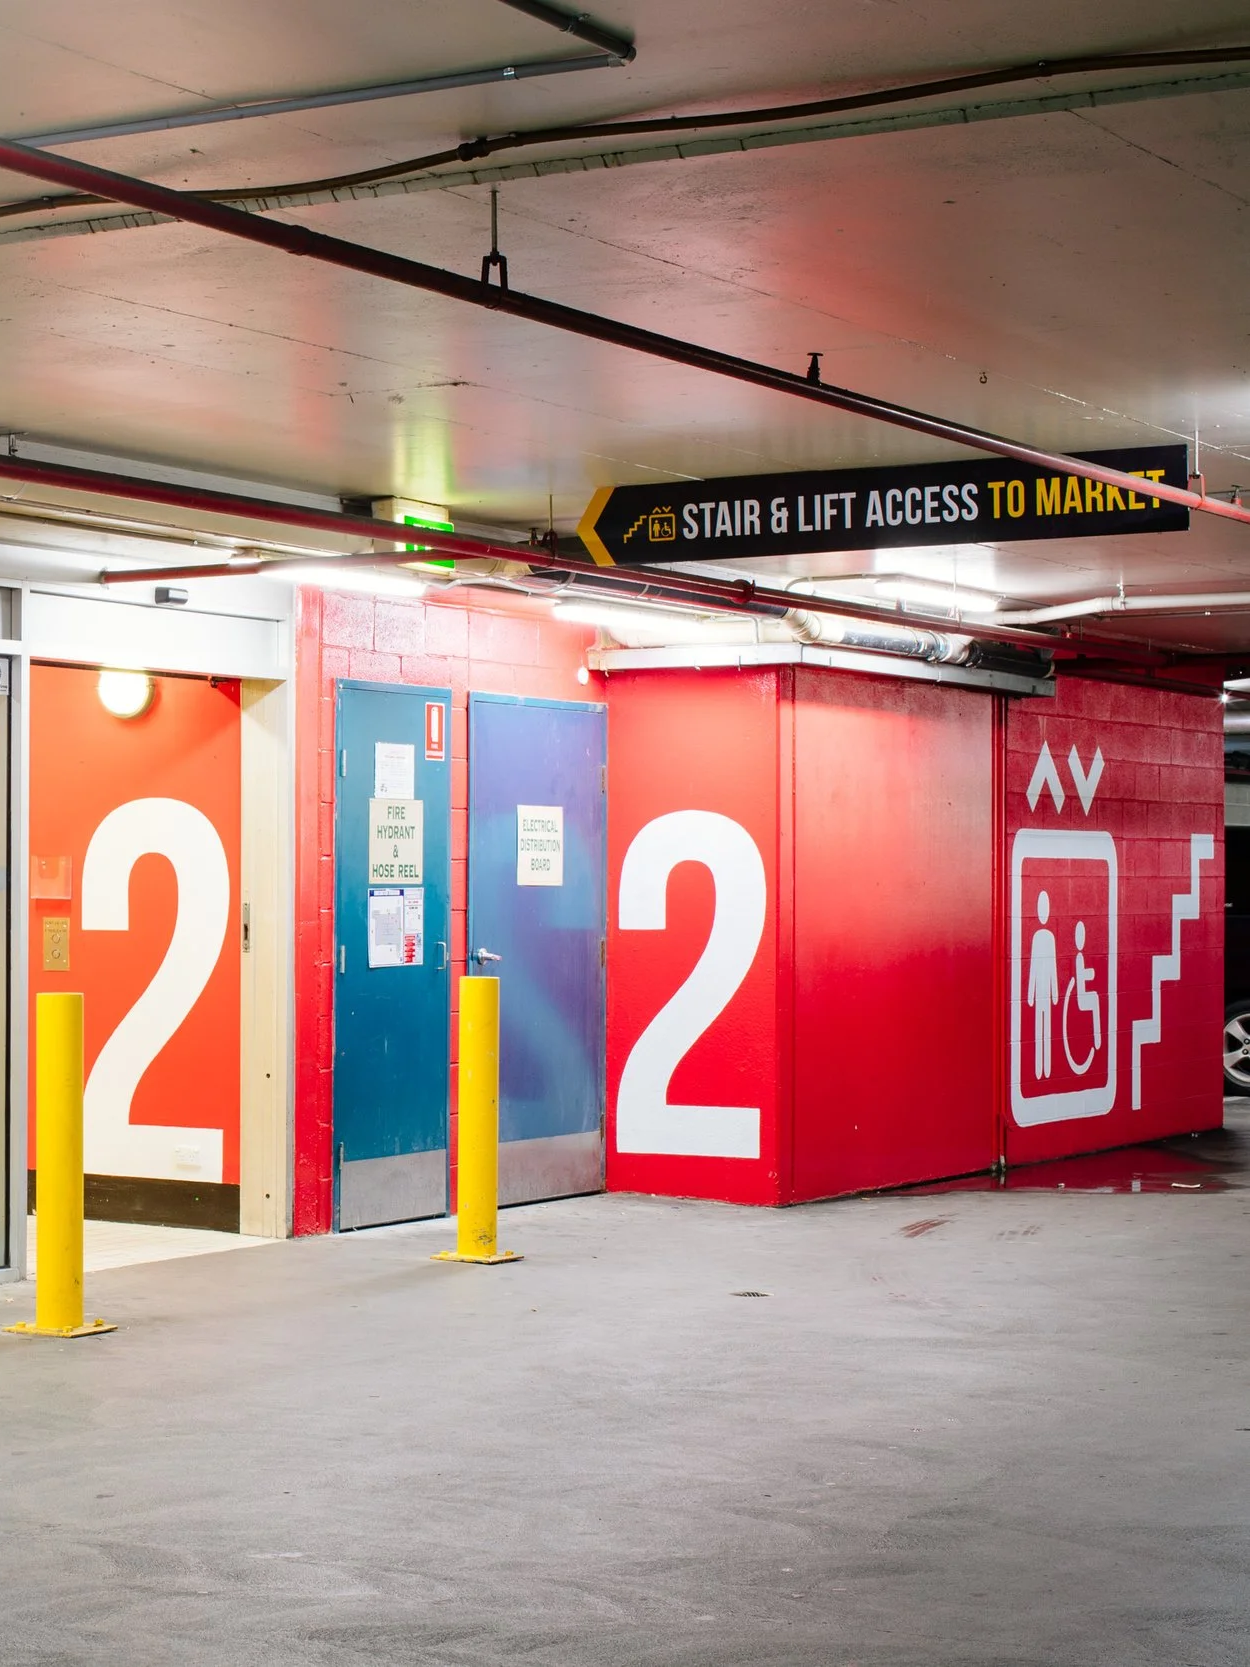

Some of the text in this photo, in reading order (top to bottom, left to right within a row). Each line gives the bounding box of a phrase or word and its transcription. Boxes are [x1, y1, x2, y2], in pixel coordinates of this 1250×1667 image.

[682, 499, 761, 540] STAIR
[770, 497, 789, 533] &
[798, 491, 857, 532] LIFT
[865, 483, 979, 528] ACCESS
[987, 480, 1025, 519] TO
[387, 806, 406, 821] FIRE
[376, 825, 416, 841] HYDRANT
[522, 819, 558, 833] ELECTRICAL
[392, 845, 399, 858] &
[520, 838, 561, 852] DISTRIBUTION
[372, 863, 419, 878] HOSE REEL
[530, 858, 551, 871] BOARD
[81, 796, 230, 1184] 2
[616, 809, 766, 1159] 2
